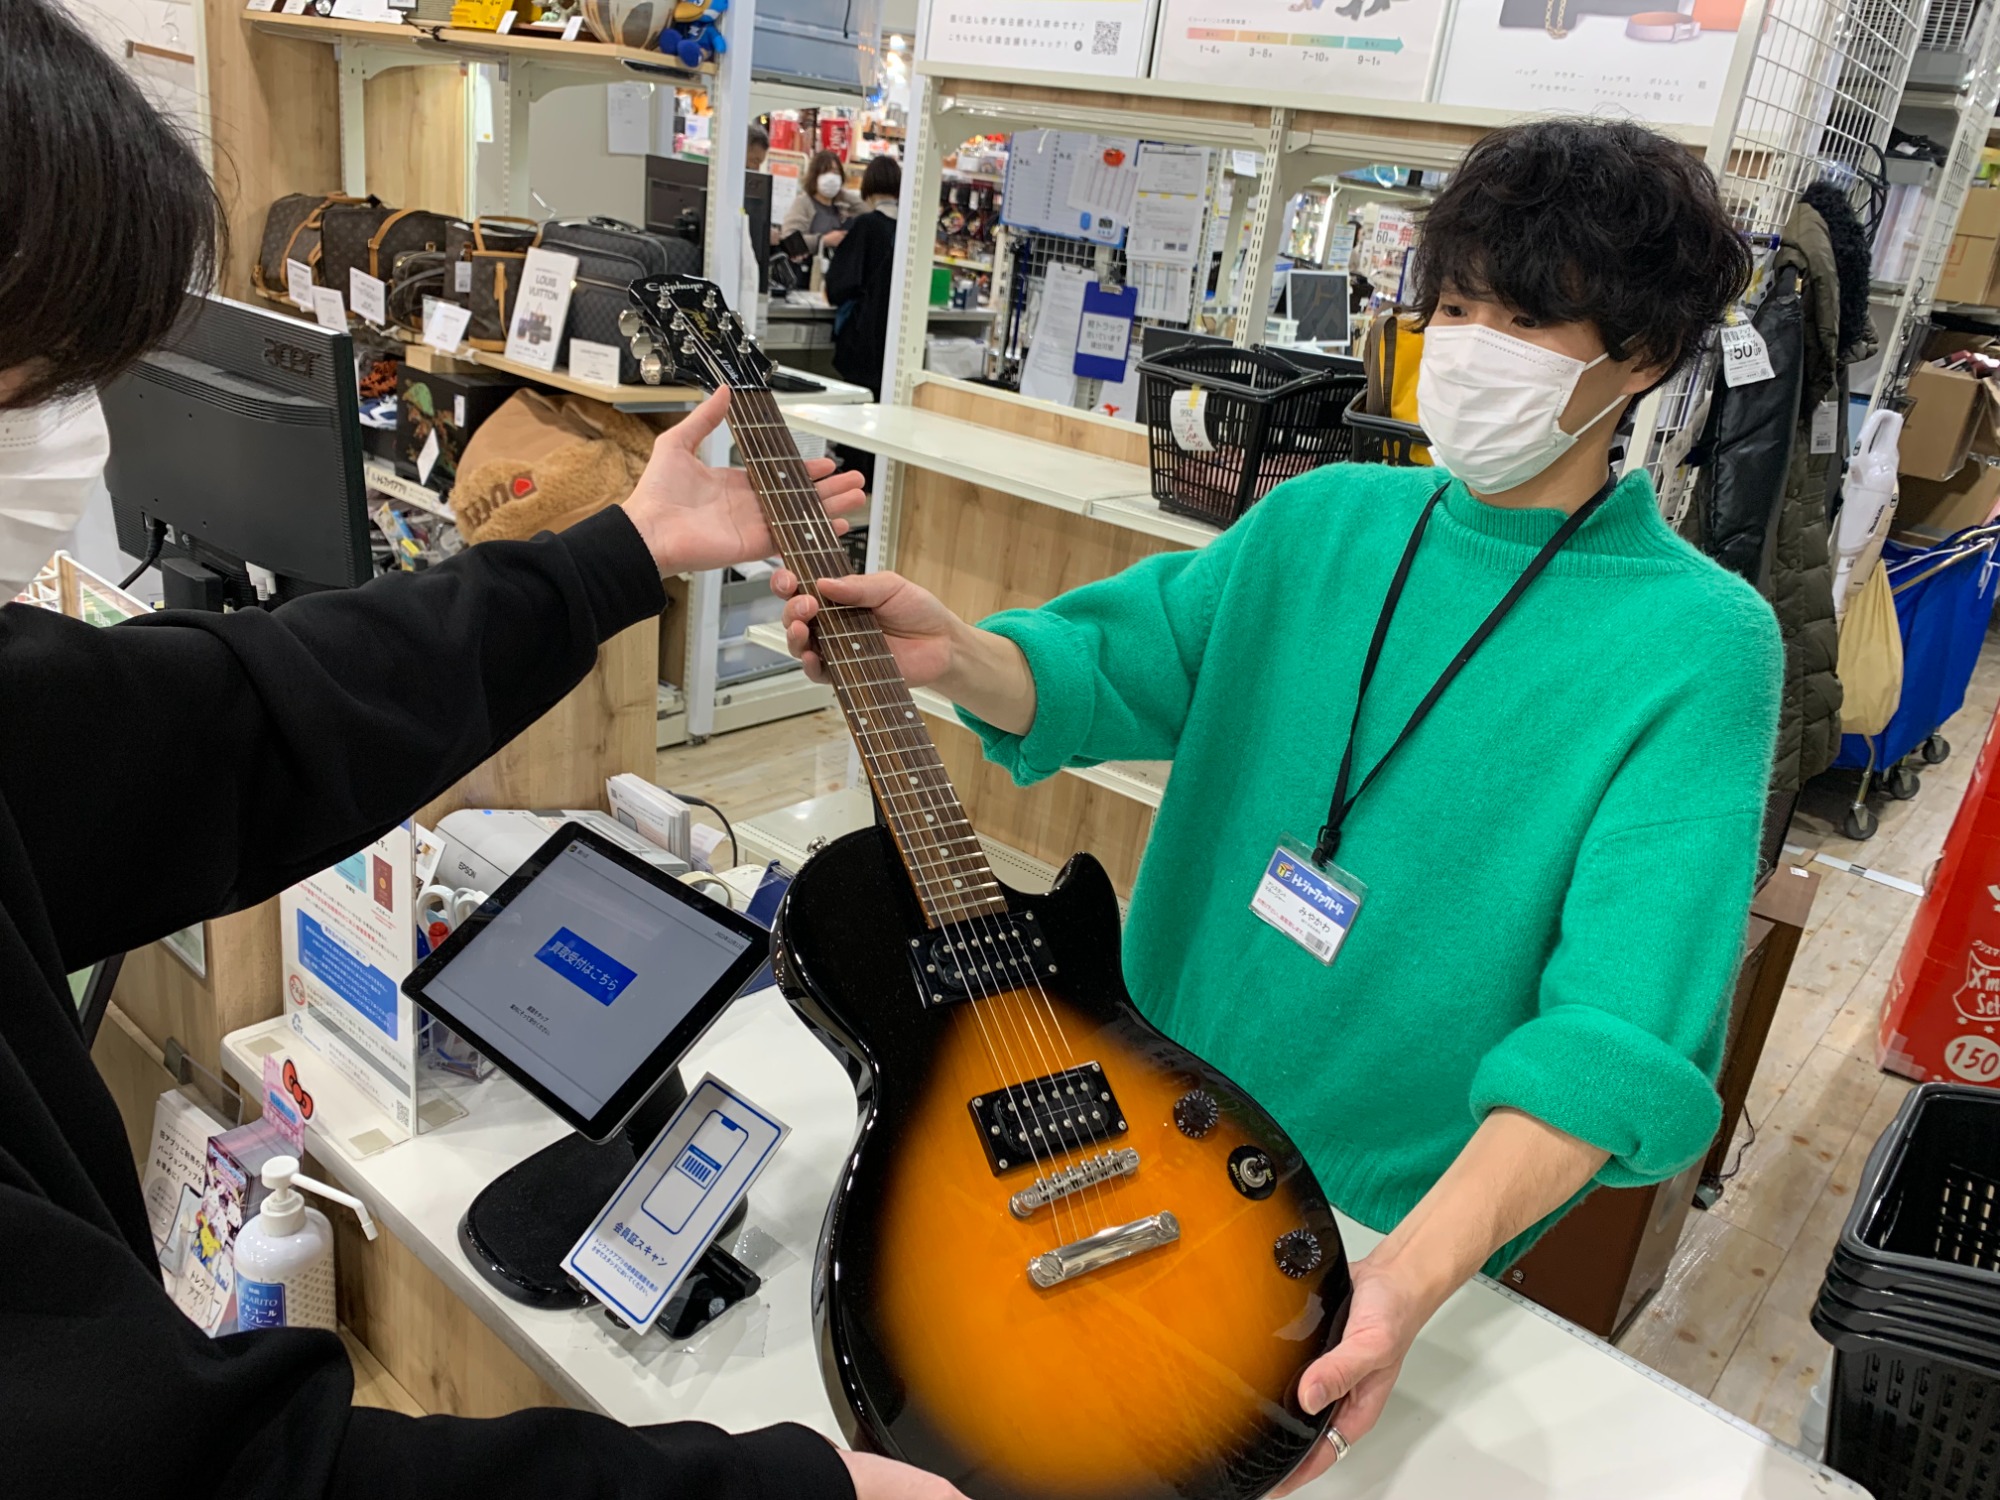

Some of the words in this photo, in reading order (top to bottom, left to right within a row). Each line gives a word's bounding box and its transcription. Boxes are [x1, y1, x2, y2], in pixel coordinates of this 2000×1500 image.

[535, 275, 557, 288] LOUIS
[644, 281, 703, 293] Epiphone
[529, 286, 559, 301] VUITTON
[264, 338, 321, 378] acer
[1733, 342, 1752, 360] 50
[1754, 347, 1761, 356] UP
[458, 861, 476, 879] EPSON
[1299, 907, 1330, 933] みやかわ
[548, 940, 619, 991] 買取受付はこちら
[1976, 993, 2000, 1016] Set
[1952, 1042, 1999, 1075] 150
[158, 1145, 202, 1185] バージョンアップを
[613, 1221, 668, 1266] 会員証スキャン
[188, 1286, 205, 1305] アプリ
[244, 1311, 273, 1324] スプレー
